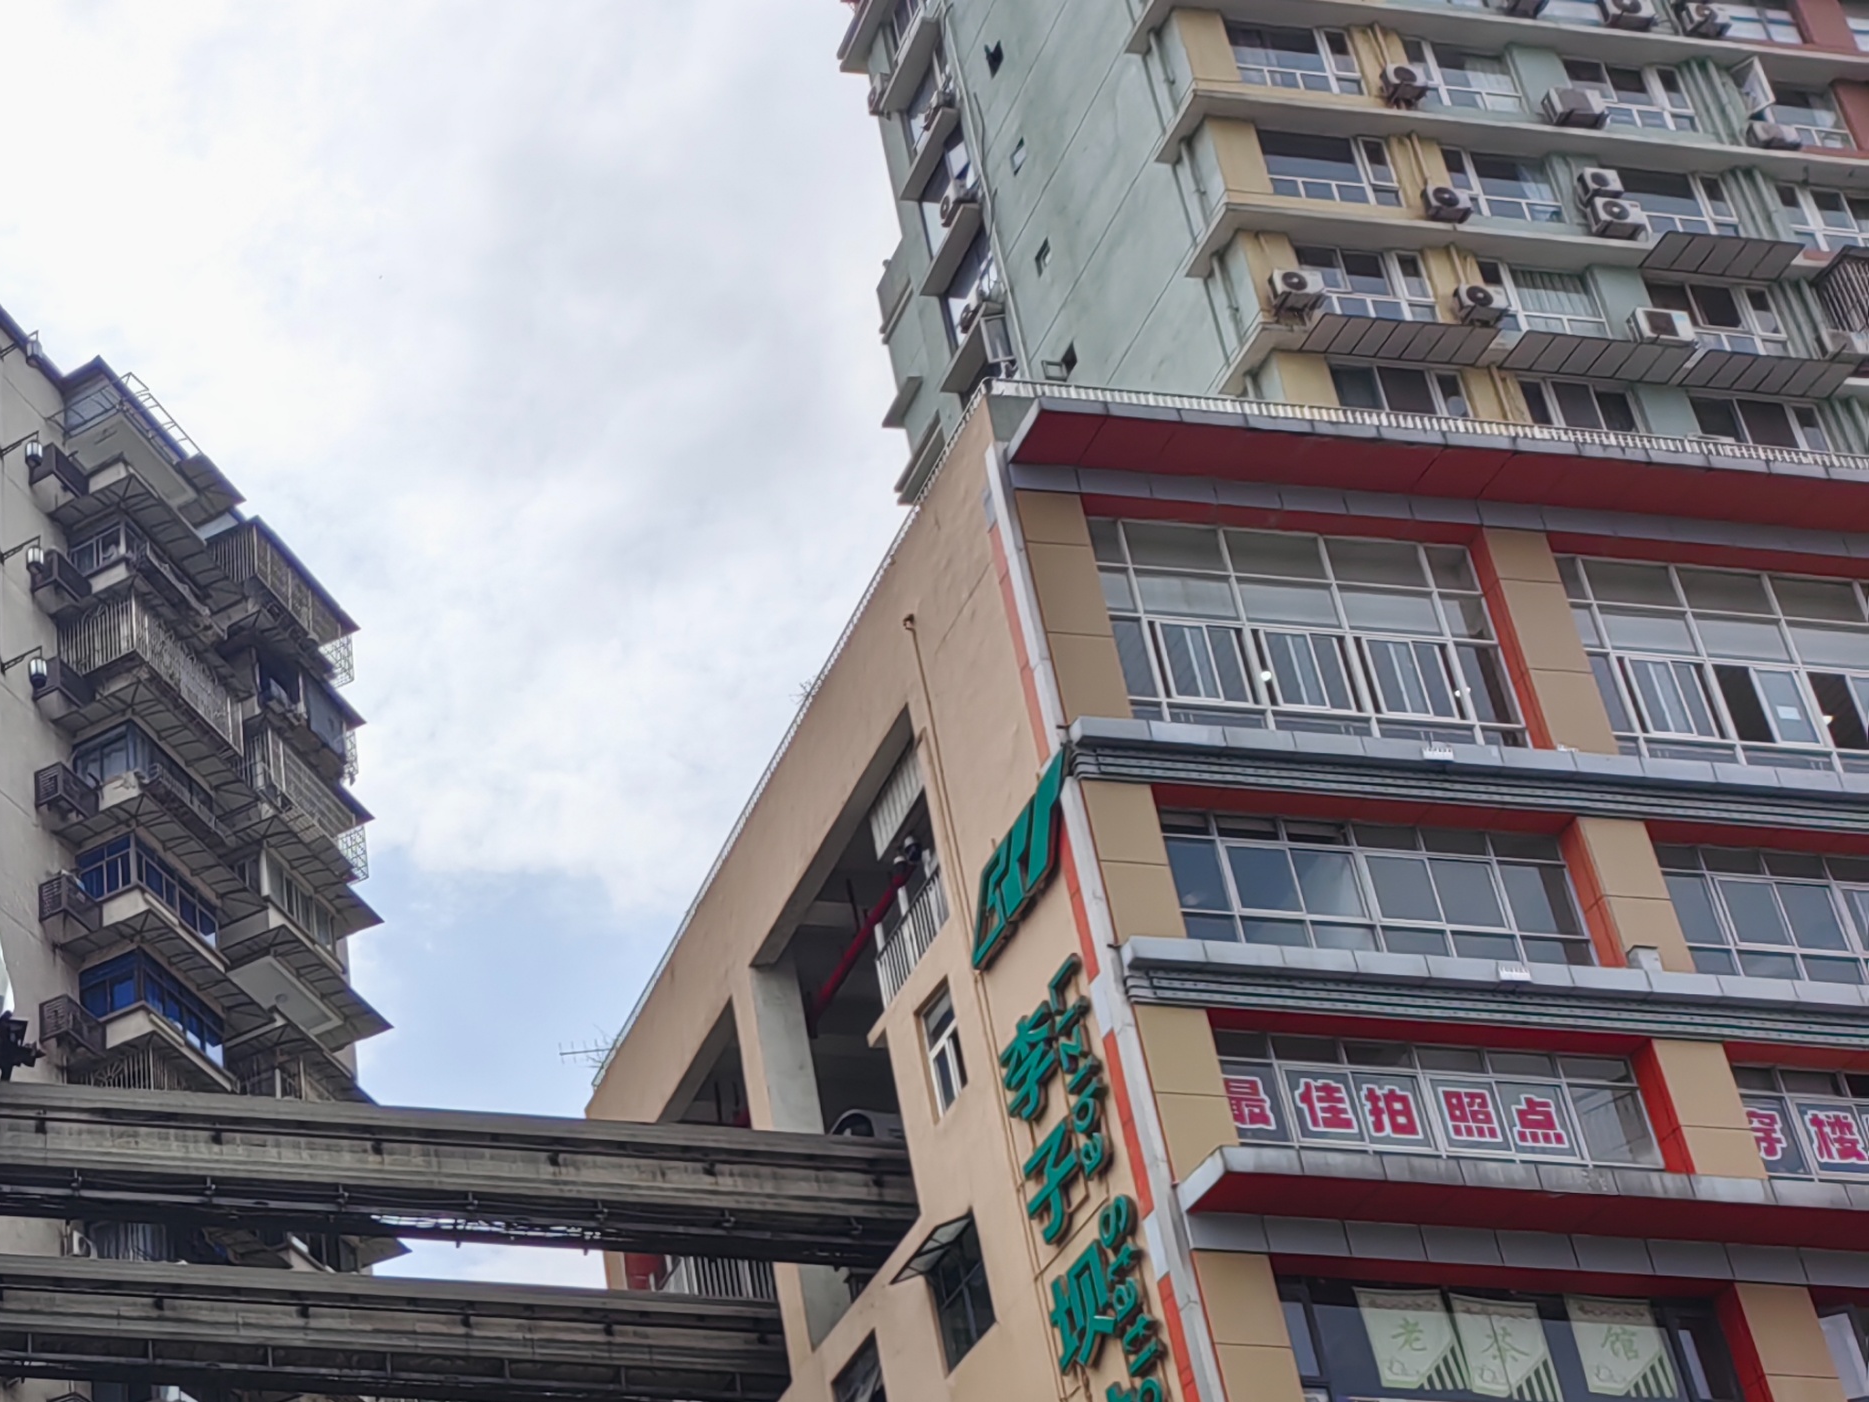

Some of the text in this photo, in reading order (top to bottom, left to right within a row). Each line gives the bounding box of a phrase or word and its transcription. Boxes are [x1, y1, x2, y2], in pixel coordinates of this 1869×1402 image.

[1048, 953, 1112, 1181] Liziba
[1223, 1076, 1570, 1148] 最佳拍照点
[1743, 1106, 1869, 1163] 穿楼
